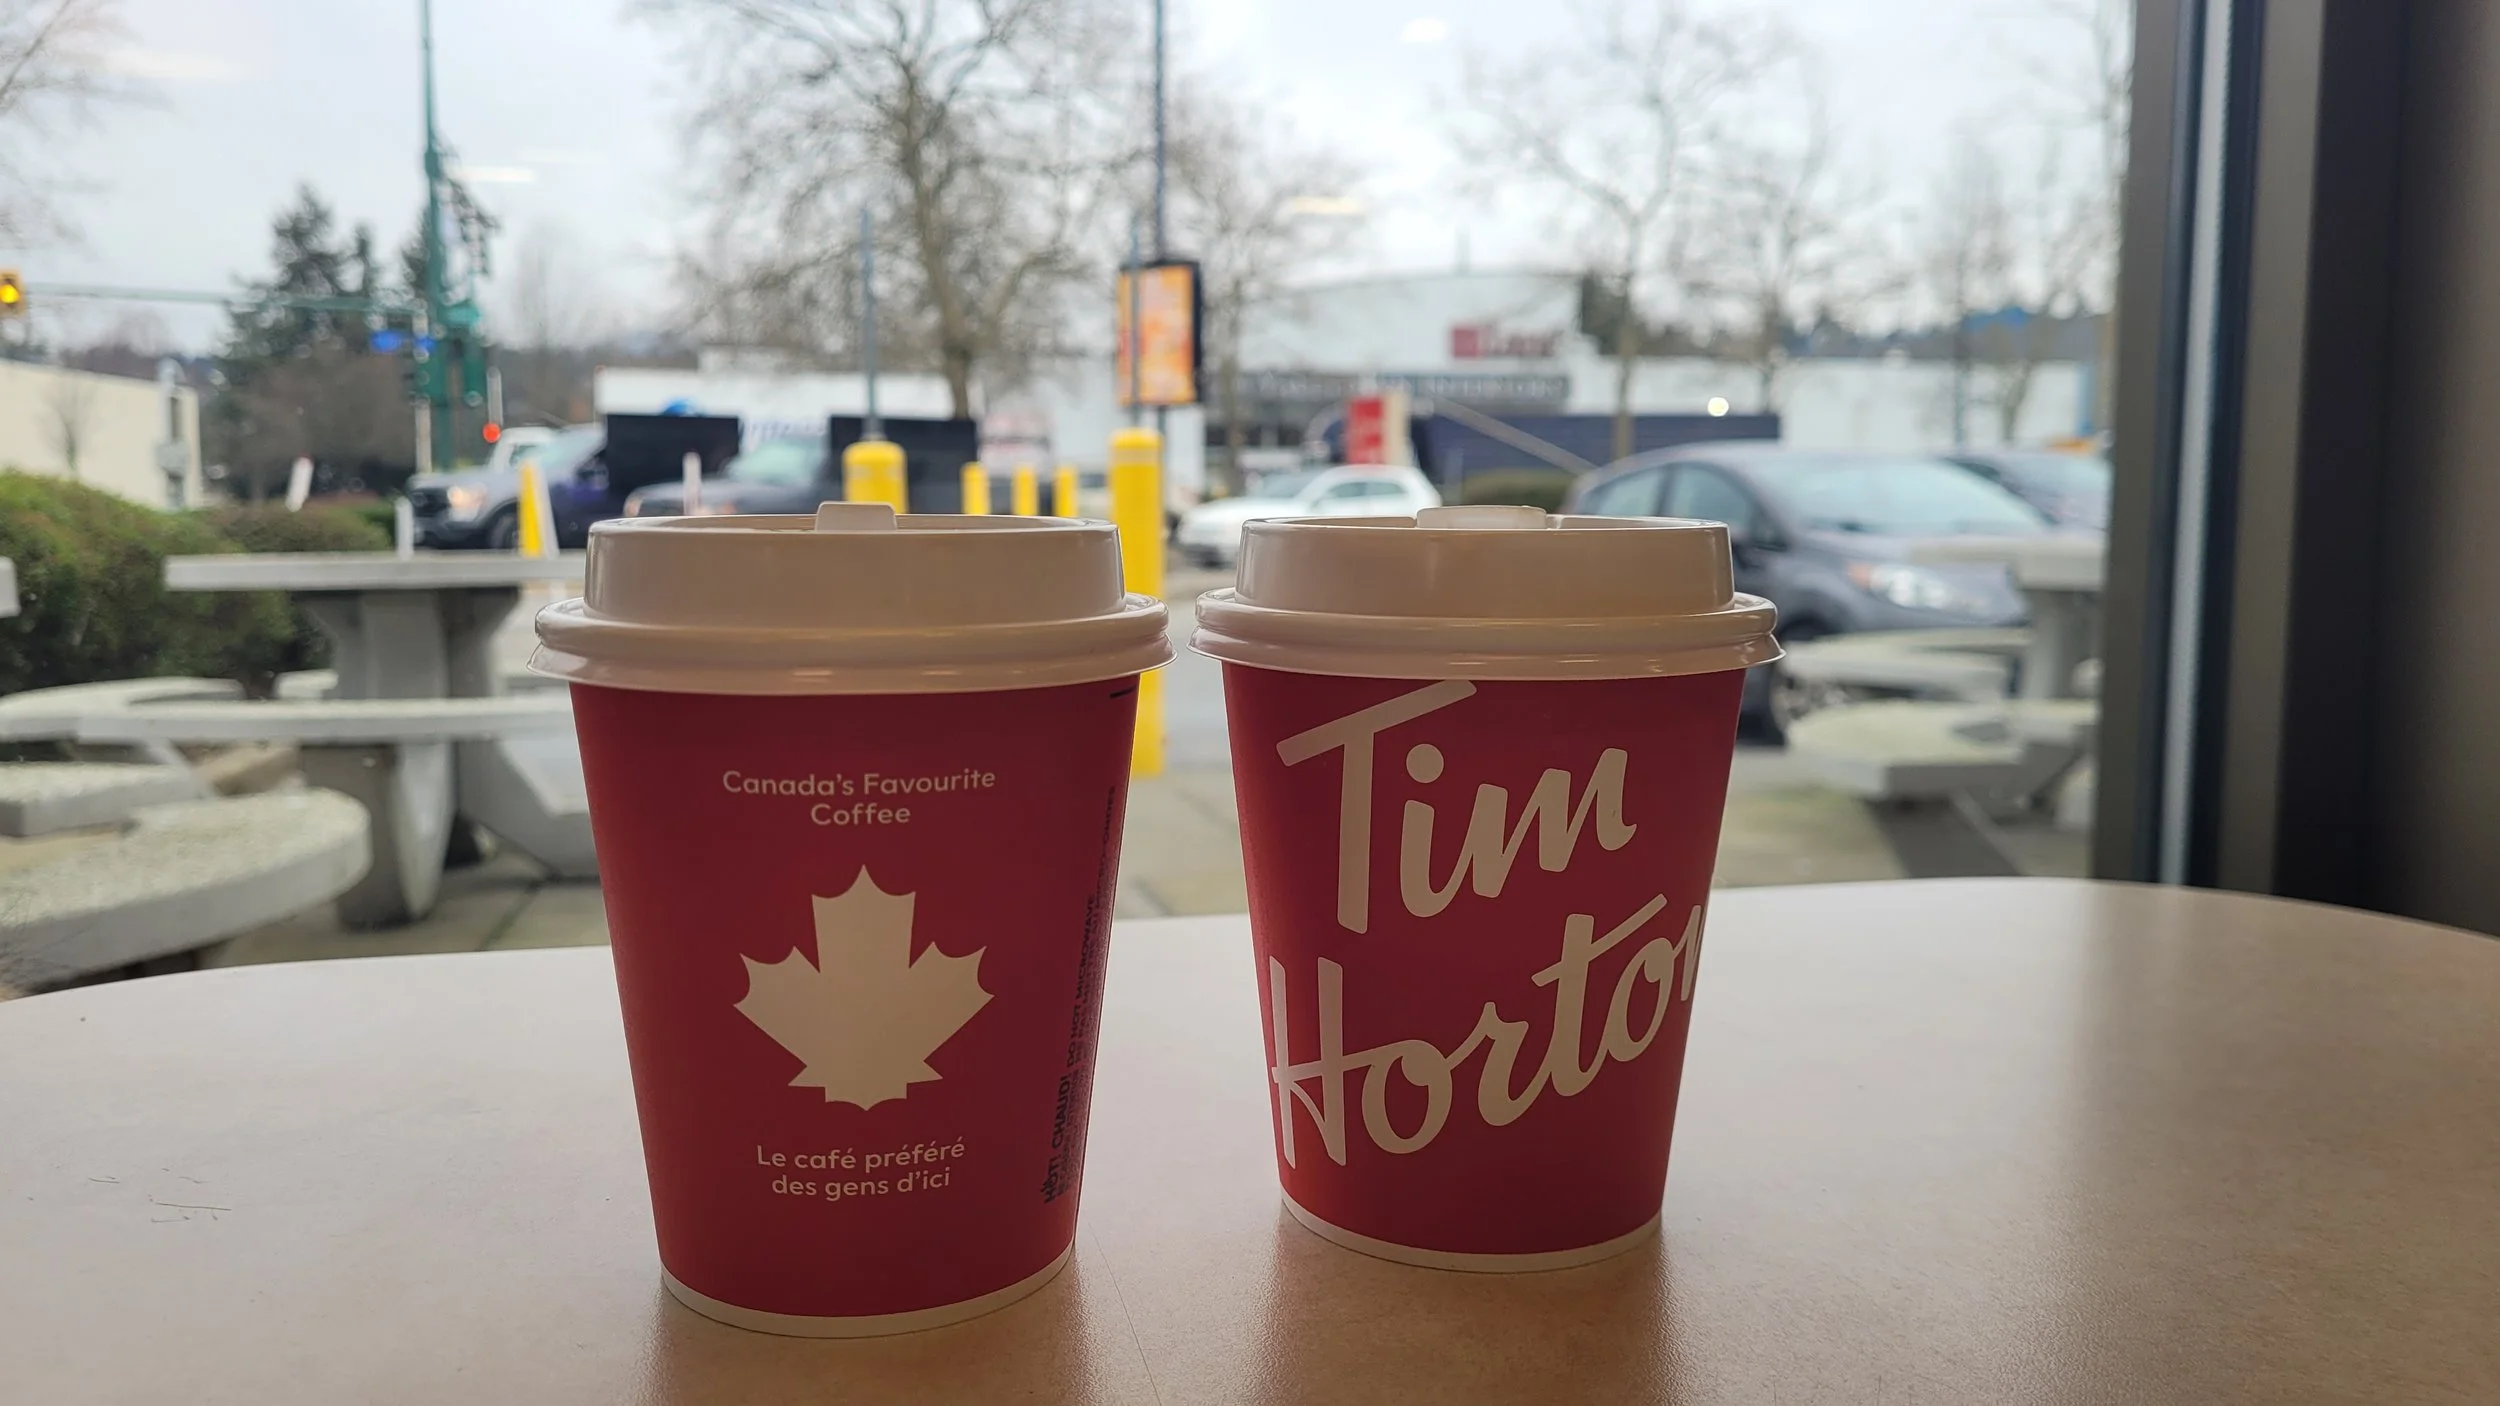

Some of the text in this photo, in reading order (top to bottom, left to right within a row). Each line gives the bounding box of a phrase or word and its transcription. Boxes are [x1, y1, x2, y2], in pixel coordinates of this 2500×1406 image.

[722, 768, 997, 796] Canada's Favourite
[810, 802, 911, 826] Coffee
[1276, 679, 1637, 934] Tim
[757, 1136, 965, 1173] Le café préféré
[772, 1166, 951, 1202] des gens d'ici
